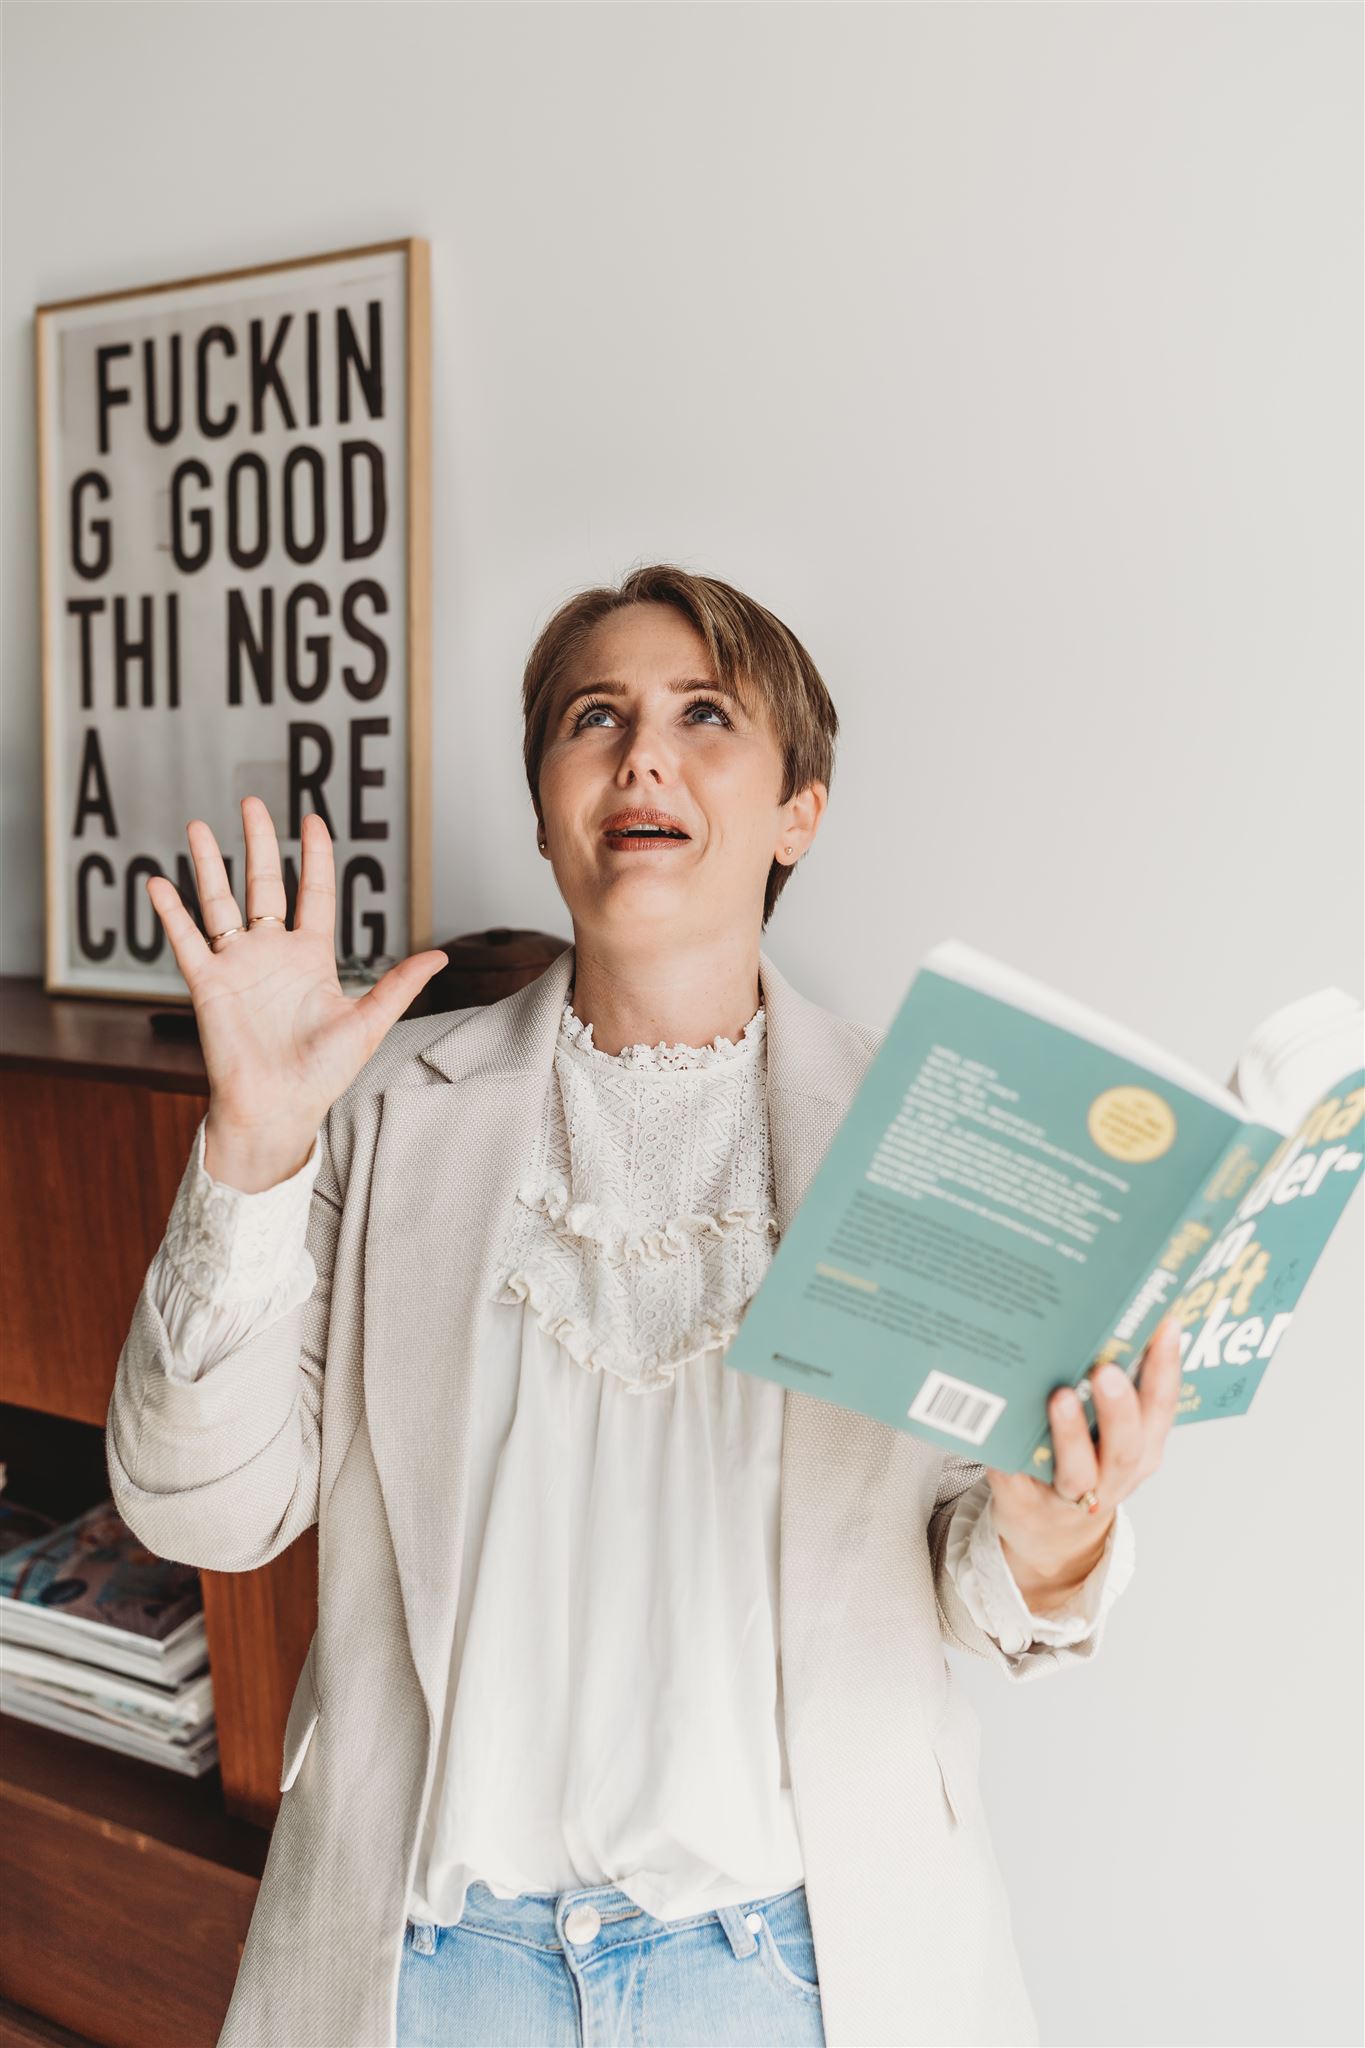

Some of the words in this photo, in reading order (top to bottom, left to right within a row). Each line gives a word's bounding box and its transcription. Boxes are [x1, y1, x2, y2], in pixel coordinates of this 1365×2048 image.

[95, 300, 385, 457] FUCKIN
[69, 468, 114, 583] G
[168, 438, 390, 576] GOOD
[66, 592, 182, 712] THI
[226, 577, 391, 705] NGS
[72, 725, 120, 840] A
[286, 715, 391, 843] RE
[75, 851, 388, 969] COG
[1179, 1296, 1295, 1374] ker
